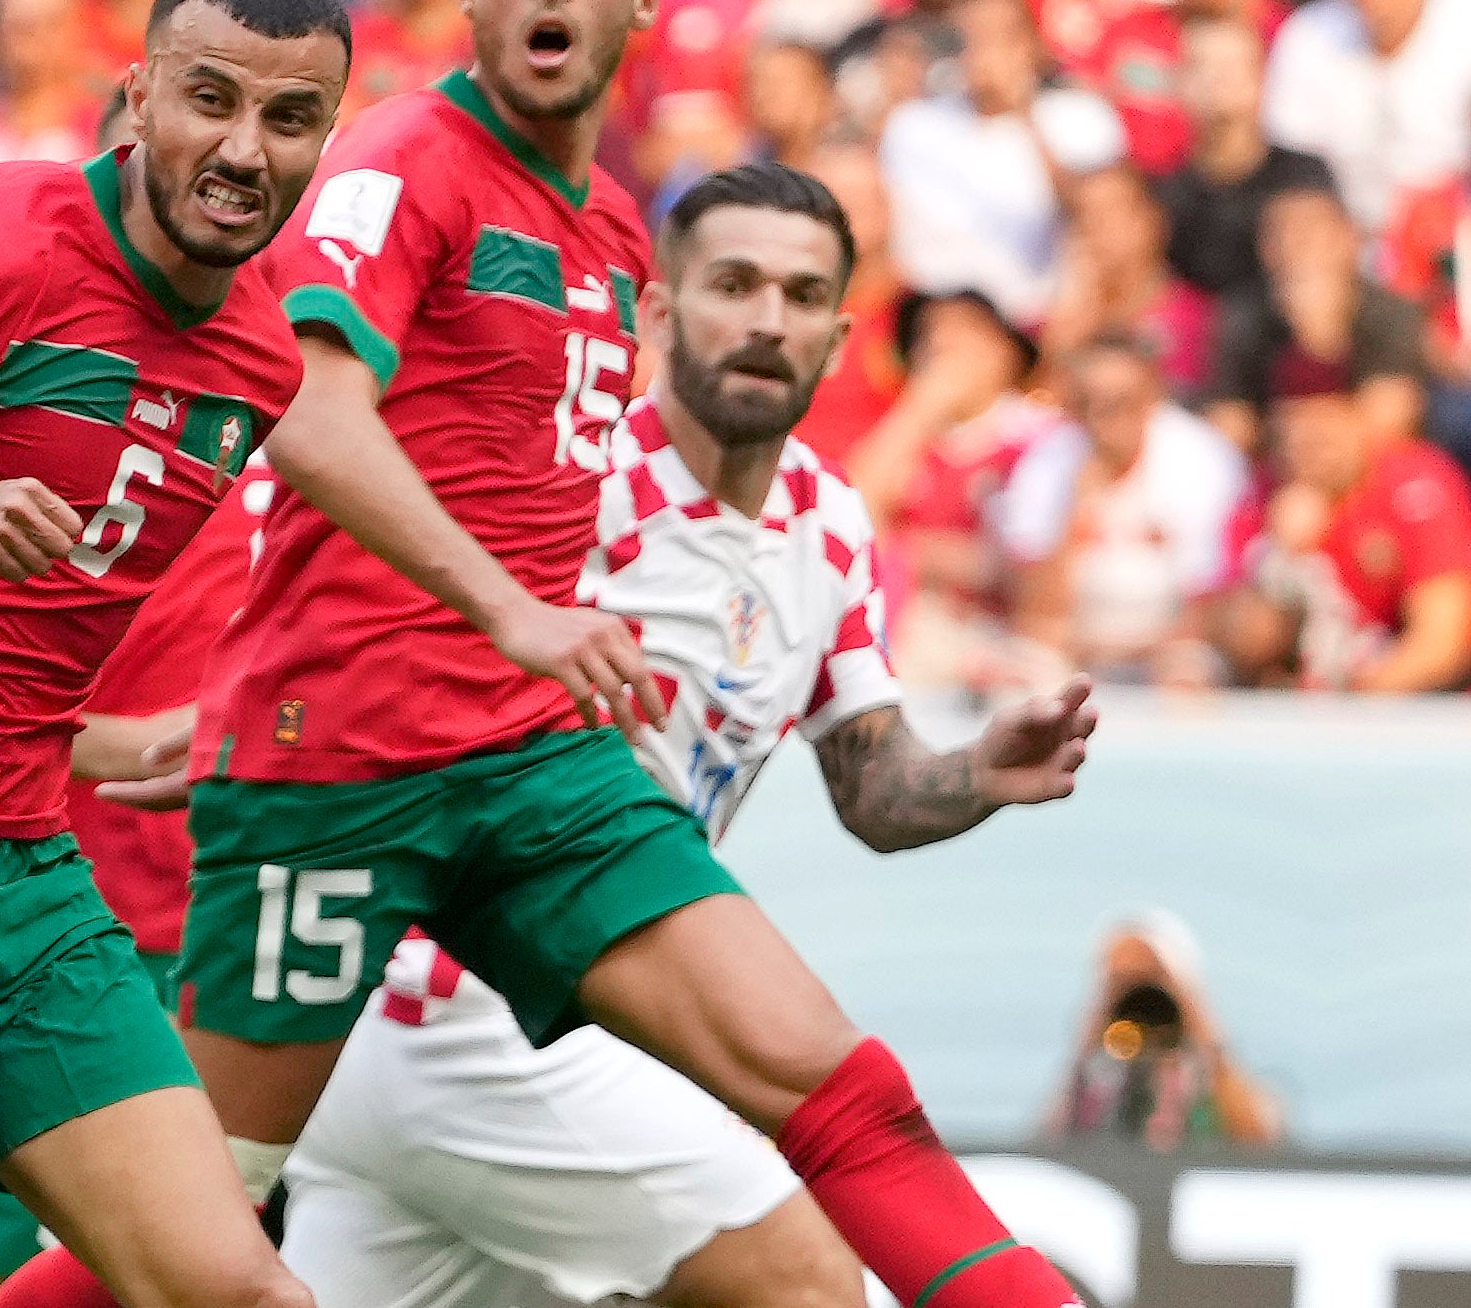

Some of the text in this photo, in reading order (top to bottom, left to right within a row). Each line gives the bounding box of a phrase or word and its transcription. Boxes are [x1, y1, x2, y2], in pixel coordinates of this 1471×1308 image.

[553, 332, 629, 474] 15
[68, 443, 166, 589] 6
[252, 863, 373, 1005] 15
